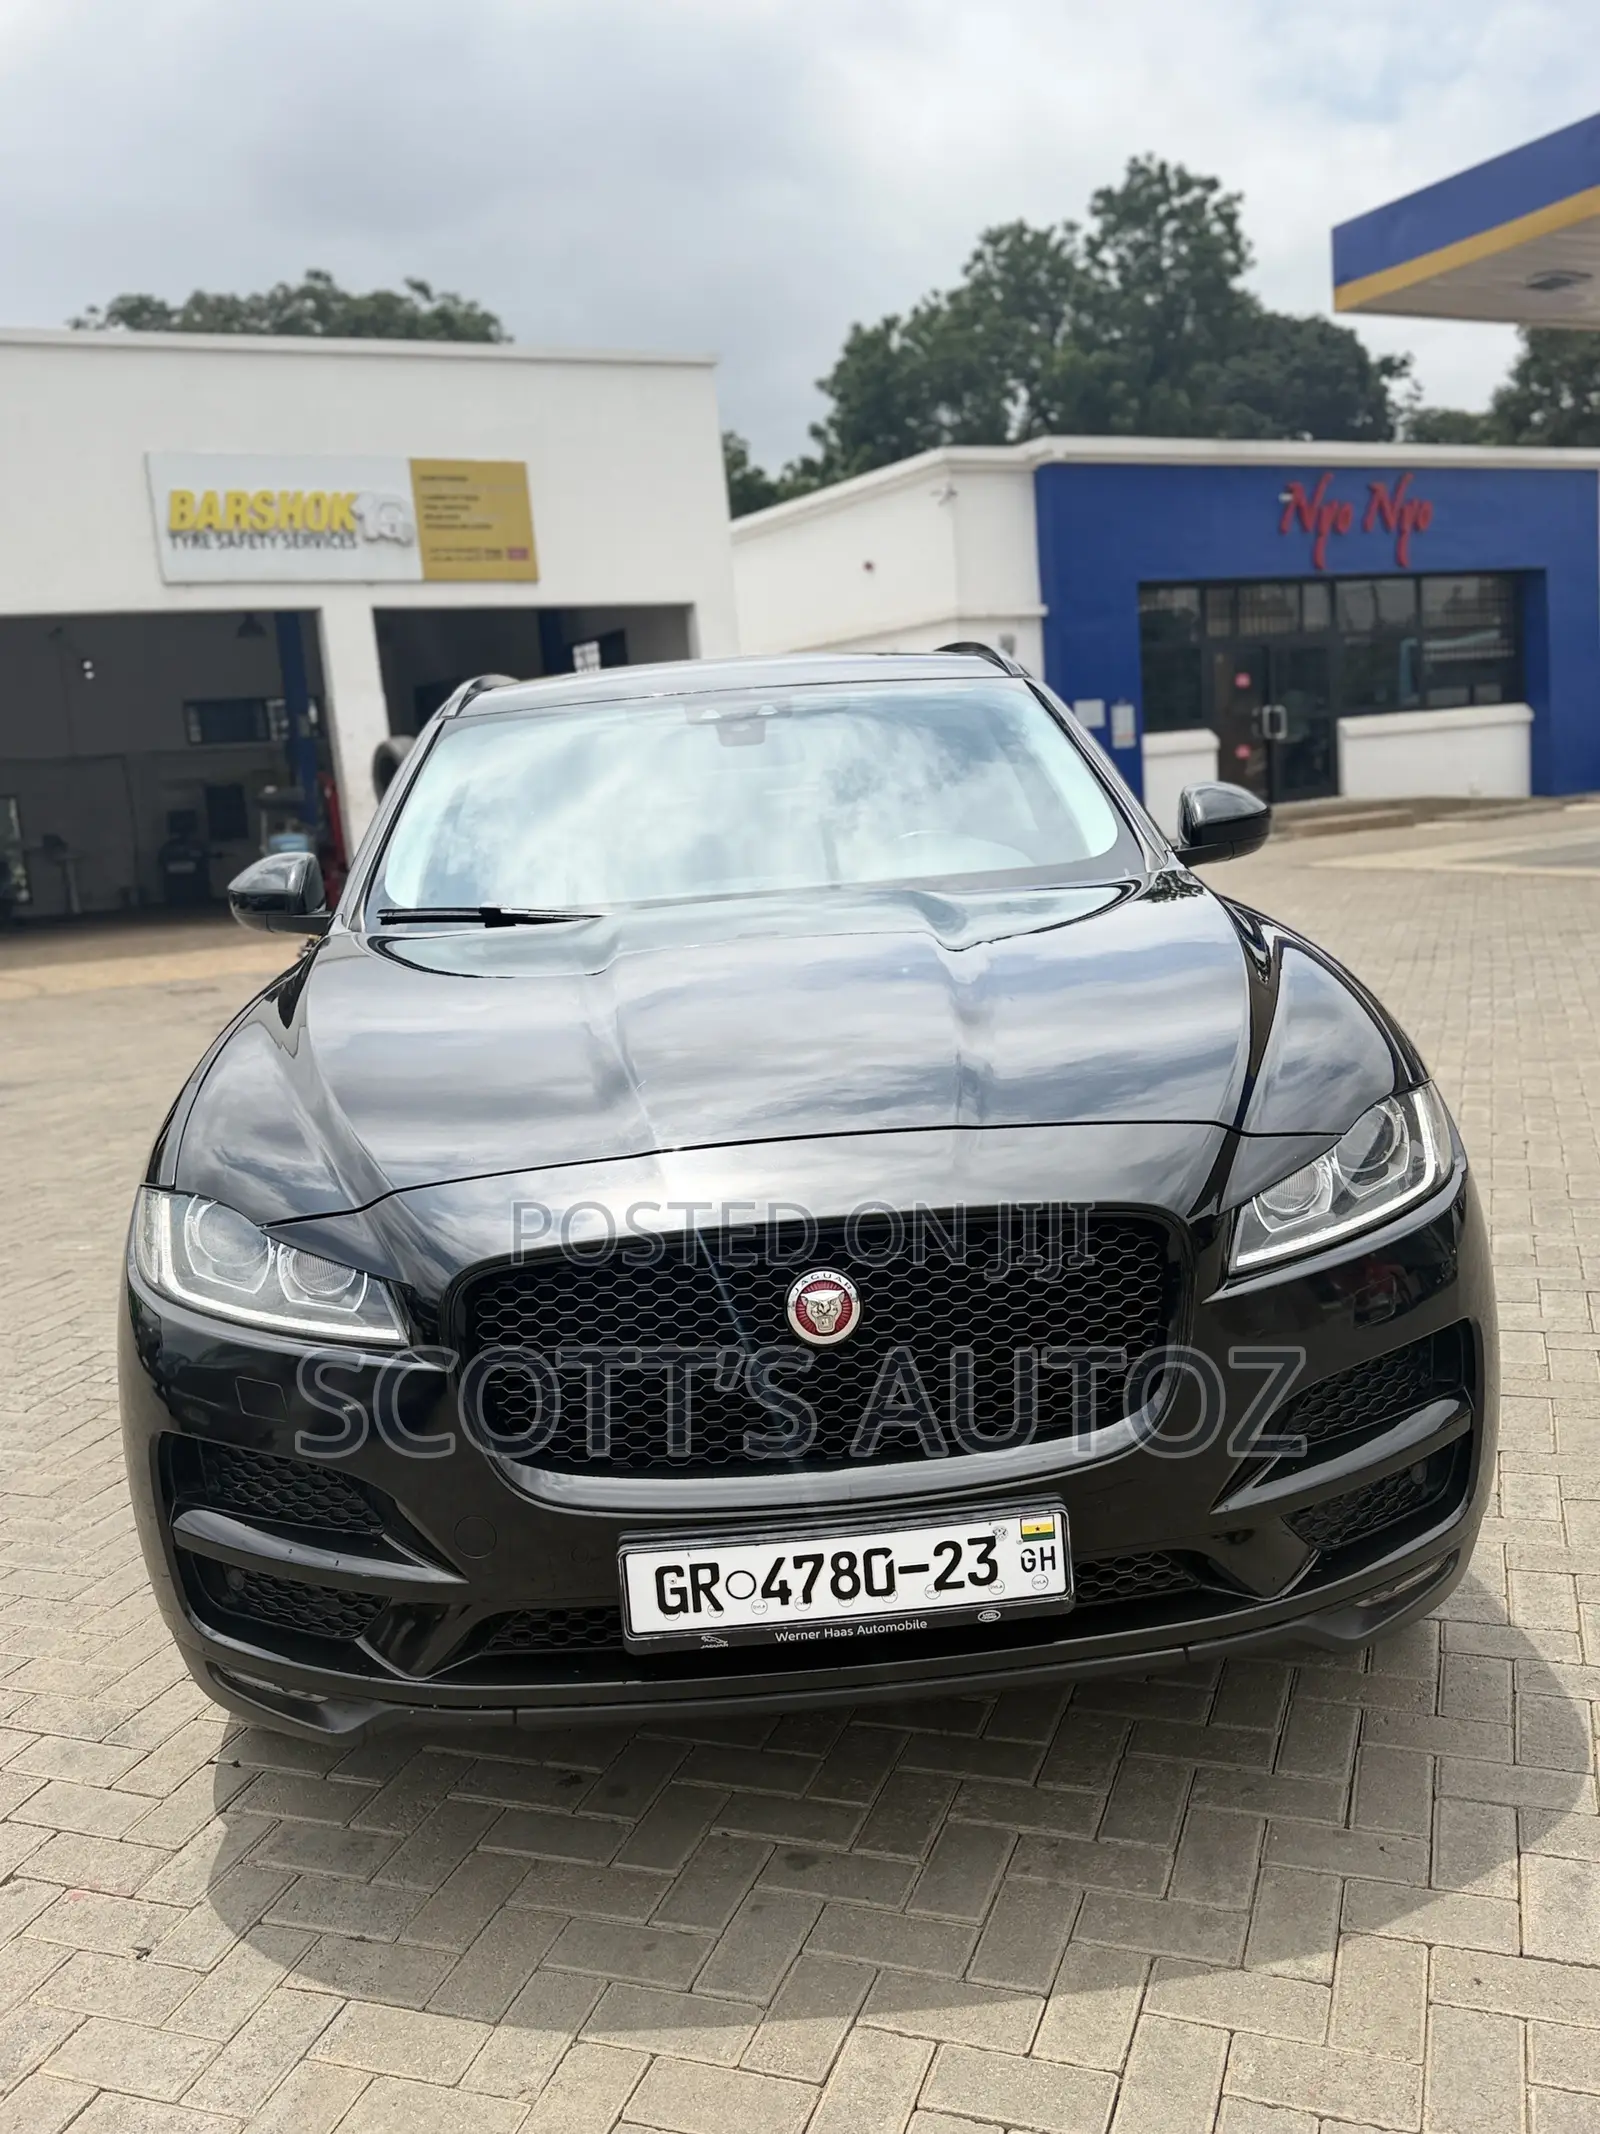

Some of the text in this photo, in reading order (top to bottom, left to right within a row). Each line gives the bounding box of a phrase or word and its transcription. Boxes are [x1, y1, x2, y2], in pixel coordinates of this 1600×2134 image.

[169, 490, 358, 532] BARSHOK
[168, 531, 358, 550] TYRE SAFETY SERVICES
[794, 1272, 852, 1296] JAGUAR
[1020, 1545, 1056, 1573] GH
[655, 1562, 724, 1615] GR
[774, 1619, 928, 1643] Werner Haas Automobile
